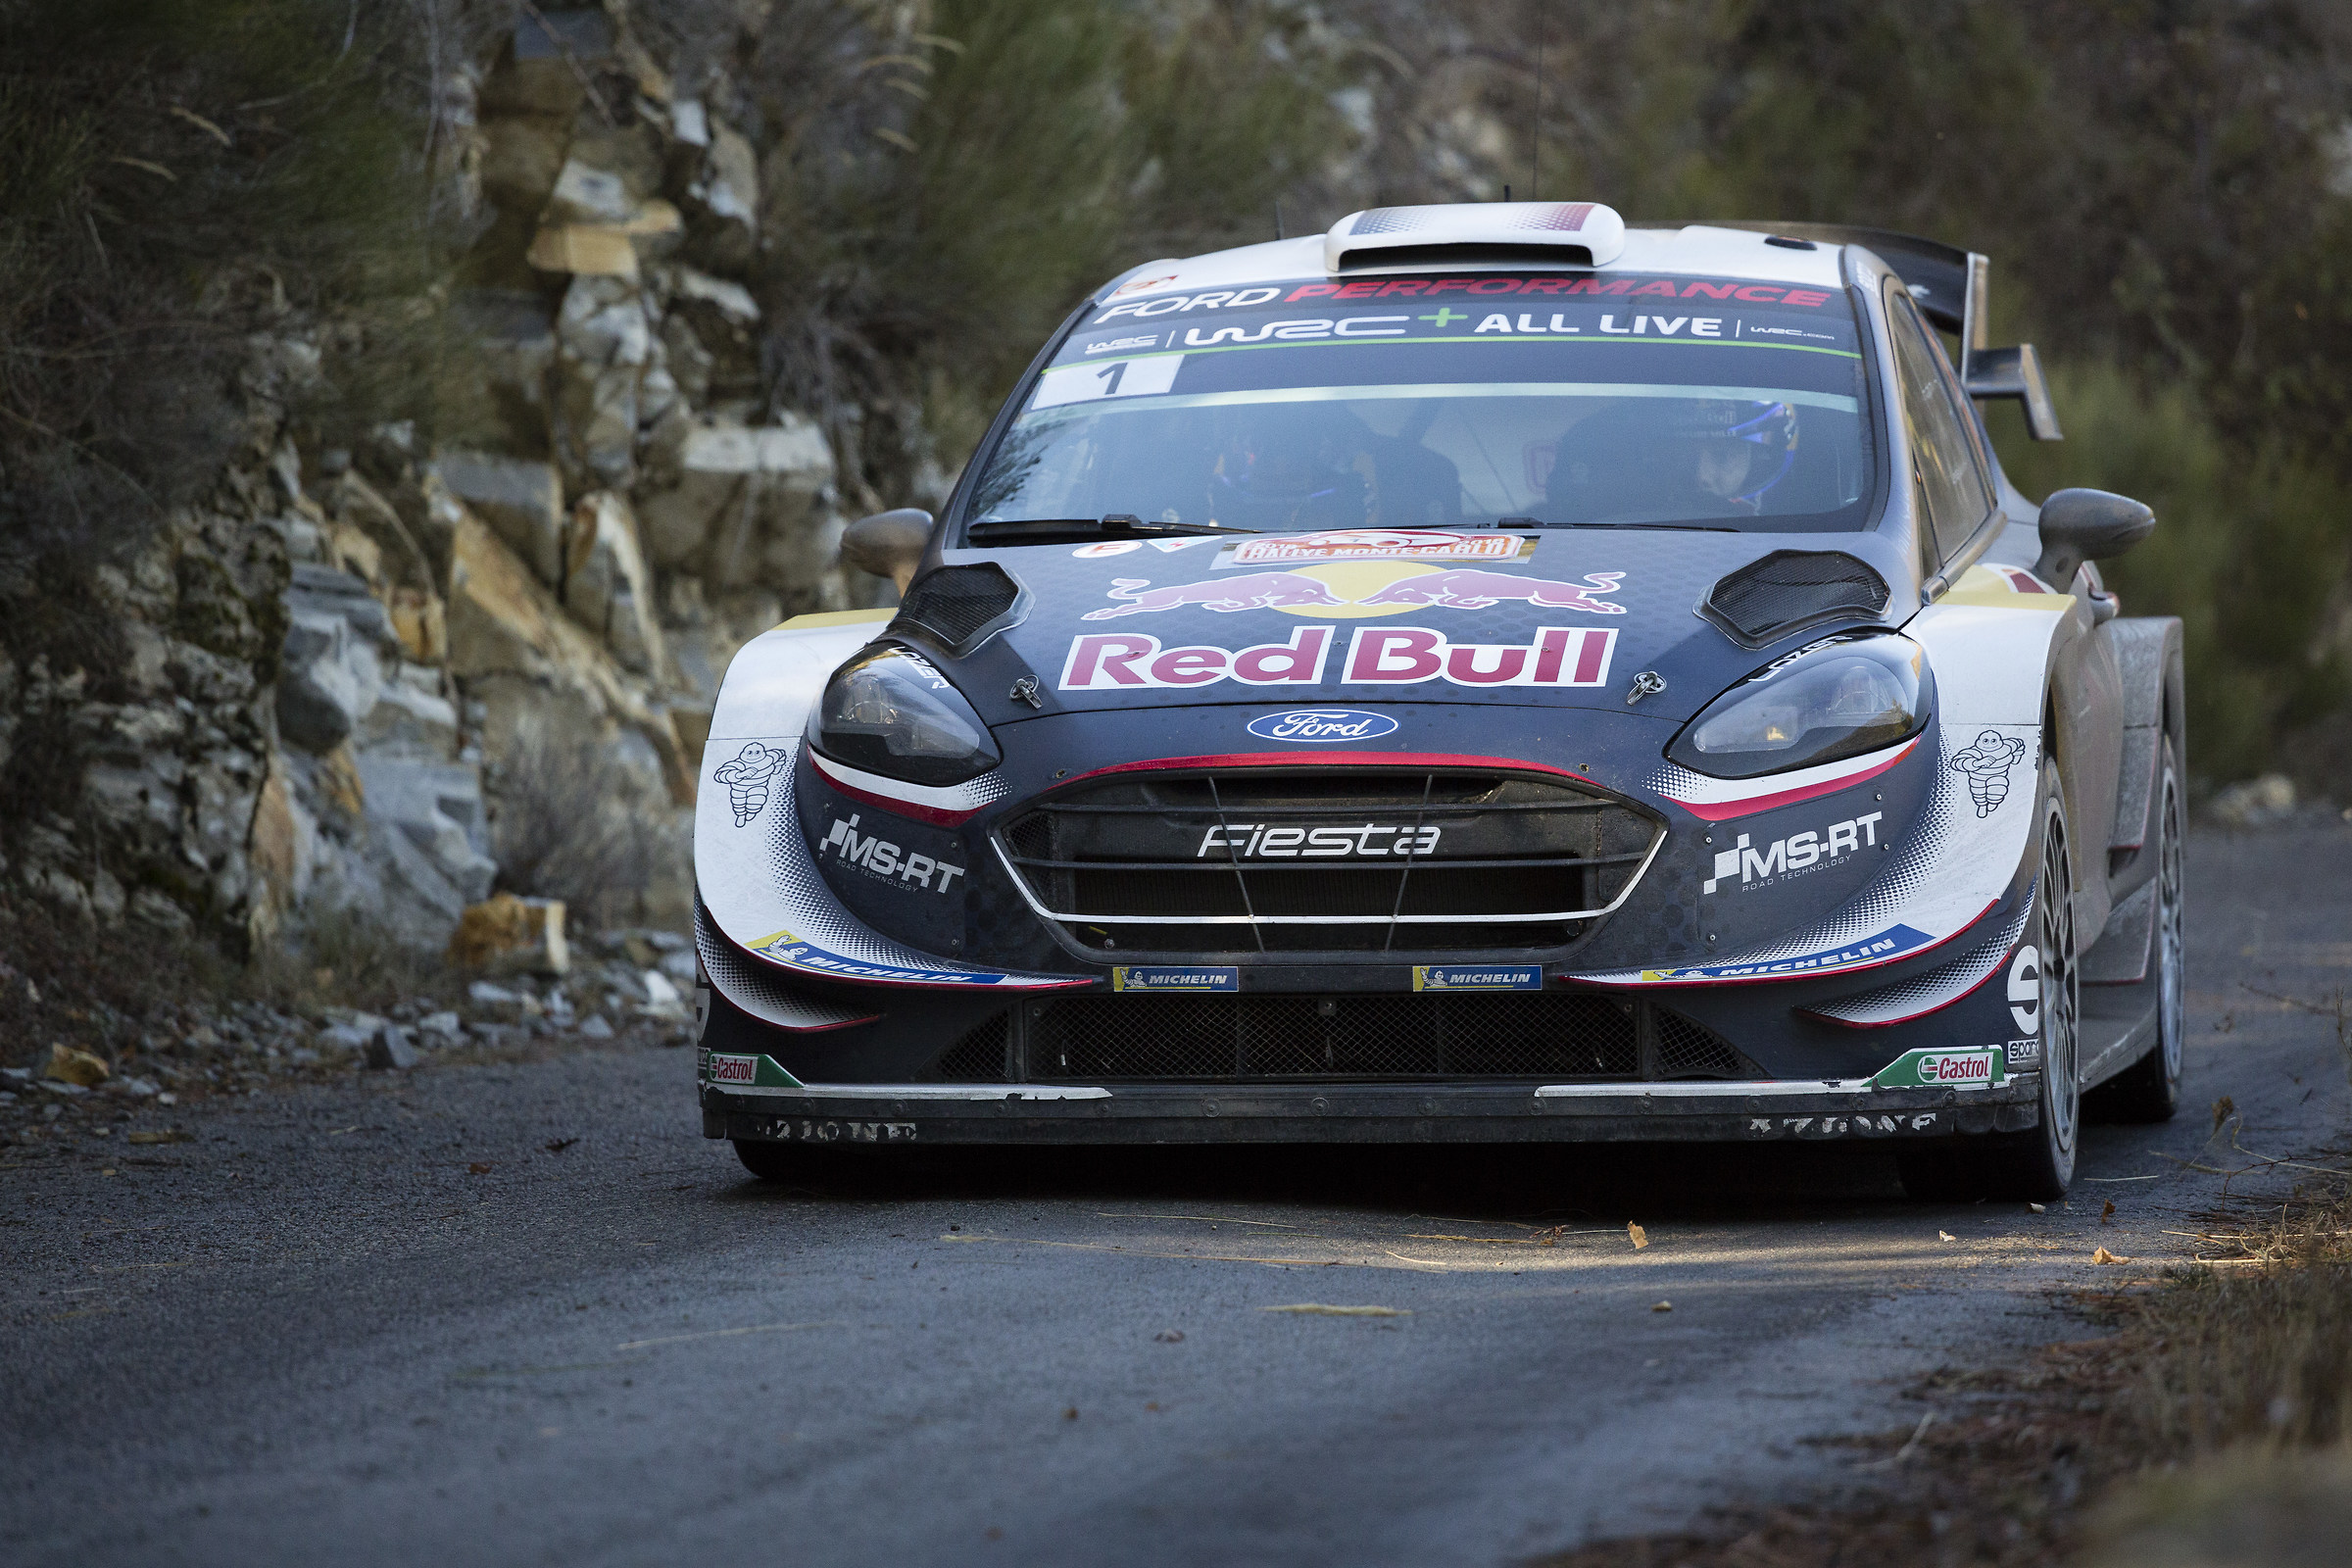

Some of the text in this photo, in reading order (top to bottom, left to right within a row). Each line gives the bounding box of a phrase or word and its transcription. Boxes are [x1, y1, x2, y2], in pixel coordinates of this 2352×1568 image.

[1094, 287, 1282, 324] FORD
[1284, 277, 1831, 308] PERFORMANCE
[1474, 313, 1580, 333] ALL
[1599, 314, 1723, 337] LIVE
[1096, 362, 1129, 395] 1
[1247, 547, 1329, 560] RALLYE
[1061, 626, 1618, 689] Red Bull
[1272, 712, 1373, 736] Ford
[1197, 823, 1442, 857] Fiesta
[835, 858, 919, 893] ROAD TECHNOLOGY
[1741, 854, 1852, 894] ROAD TECHNOLOGY
[804, 955, 973, 983] MICHELIN
[1719, 938, 1896, 976] MICHELIN
[1149, 973, 1228, 985] MICHELIN
[1448, 972, 1531, 984] MICHELIN
[717, 1056, 754, 1081] Castrol
[1938, 1055, 1990, 1080] Castrol
